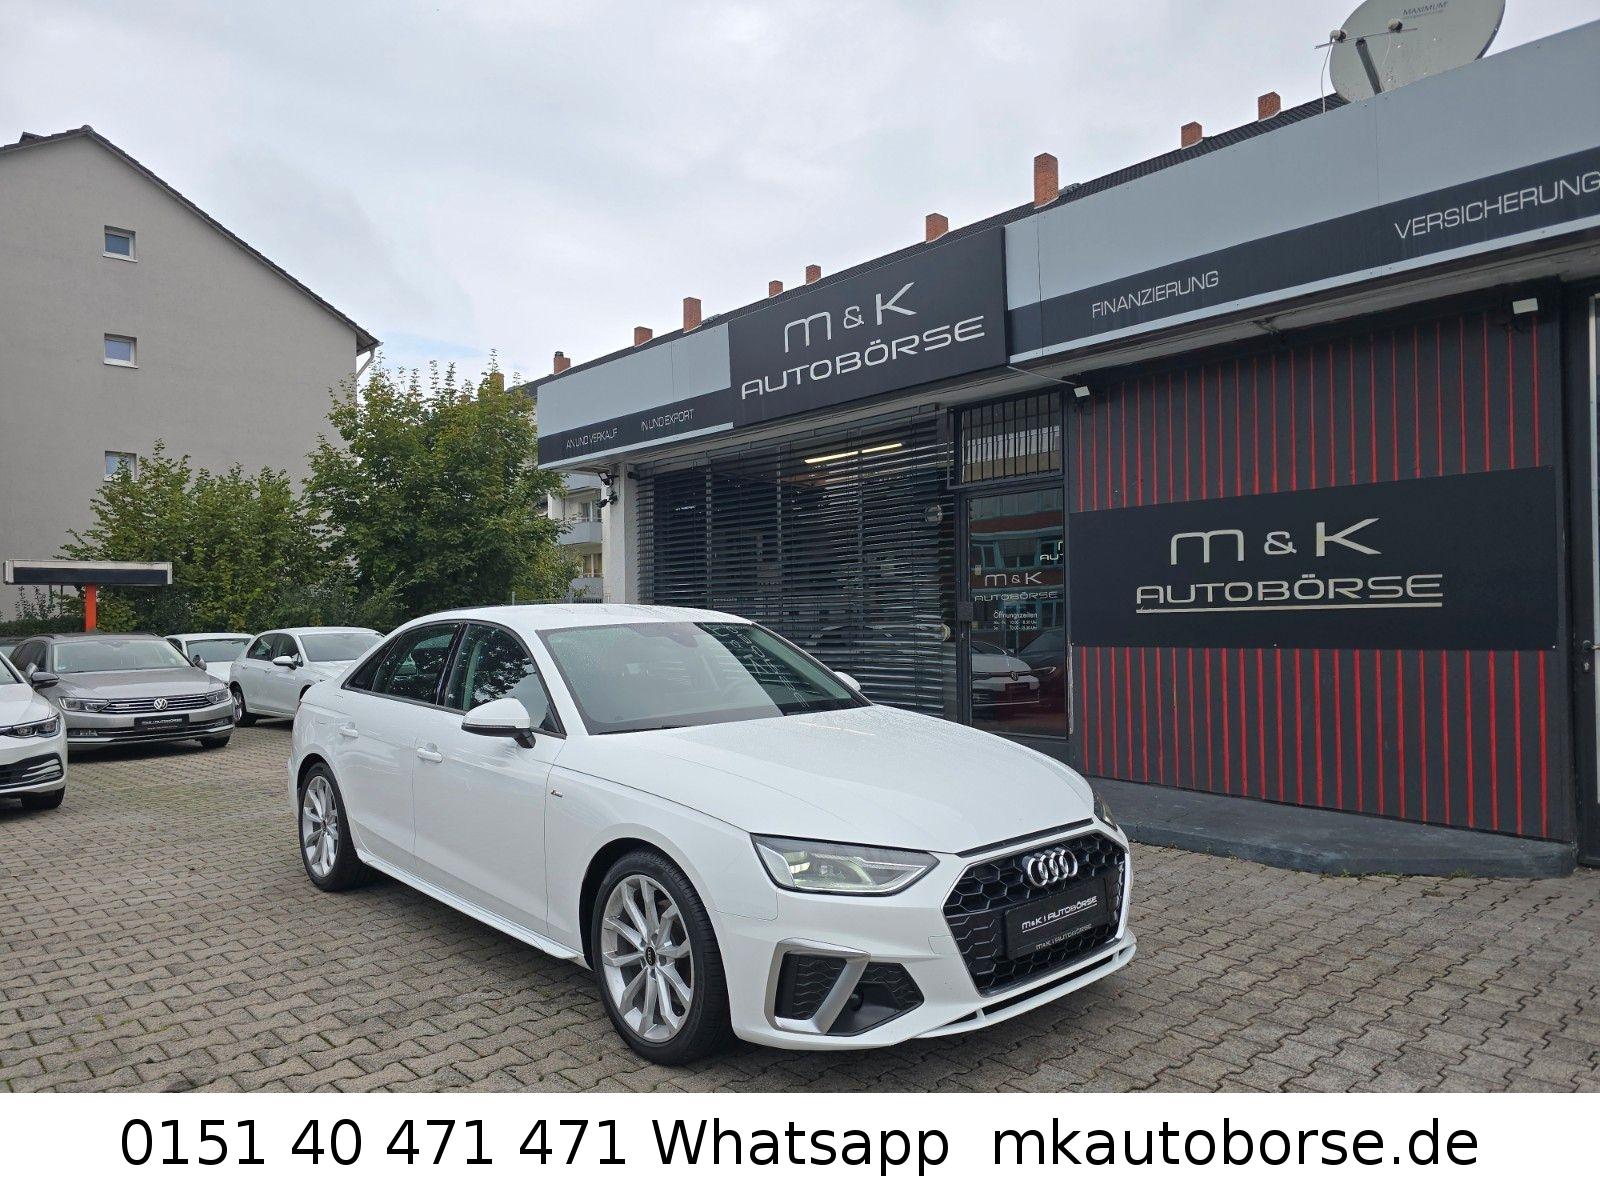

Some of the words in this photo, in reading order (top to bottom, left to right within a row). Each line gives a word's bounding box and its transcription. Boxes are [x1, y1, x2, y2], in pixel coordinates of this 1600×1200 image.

[1402, 1, 1448, 16] MAXIMUM
[1394, 171, 1600, 239] VERSICHERUNG
[843, 305, 865, 329] &
[875, 281, 917, 326] K
[1092, 270, 1219, 319] FINANZIERUNG
[741, 315, 986, 400] AUTOBÖRSE
[1263, 530, 1297, 555] &
[1316, 517, 1383, 557] K
[1025, 571, 1043, 585] K
[1136, 573, 1444, 604] AUTOBÖRSE
[974, 591, 1058, 602] AUTOBÖRSE
[1047, 895, 1098, 921] AUTOBÖRSE
